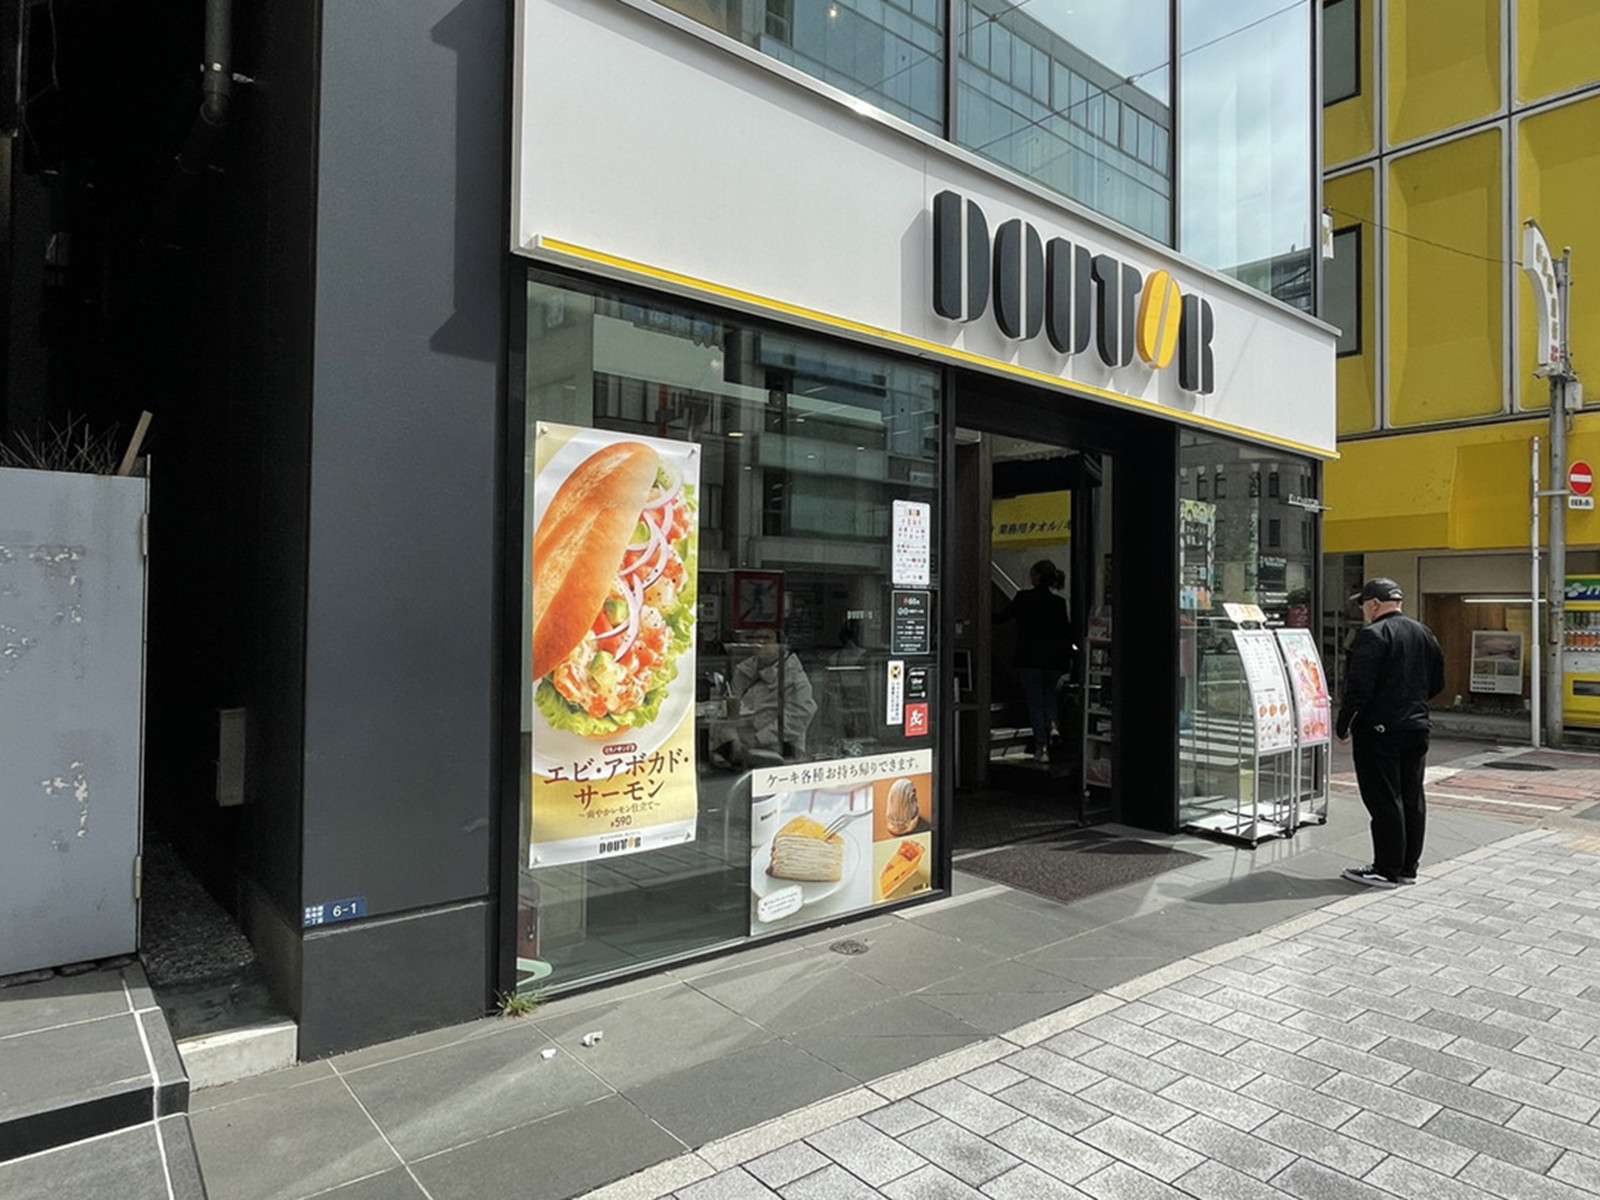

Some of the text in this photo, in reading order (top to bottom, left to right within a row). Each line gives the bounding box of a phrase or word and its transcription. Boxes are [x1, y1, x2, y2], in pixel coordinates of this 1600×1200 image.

[933, 189, 1214, 395] DOUTOR
[544, 748, 689, 784] エビ・アボカド・
[767, 757, 919, 787] ケーキ各種お持ち帰りできます。
[574, 779, 665, 810] サーモン
[599, 836, 641, 854] DOUTOR
[333, 903, 357, 917] 6-1
